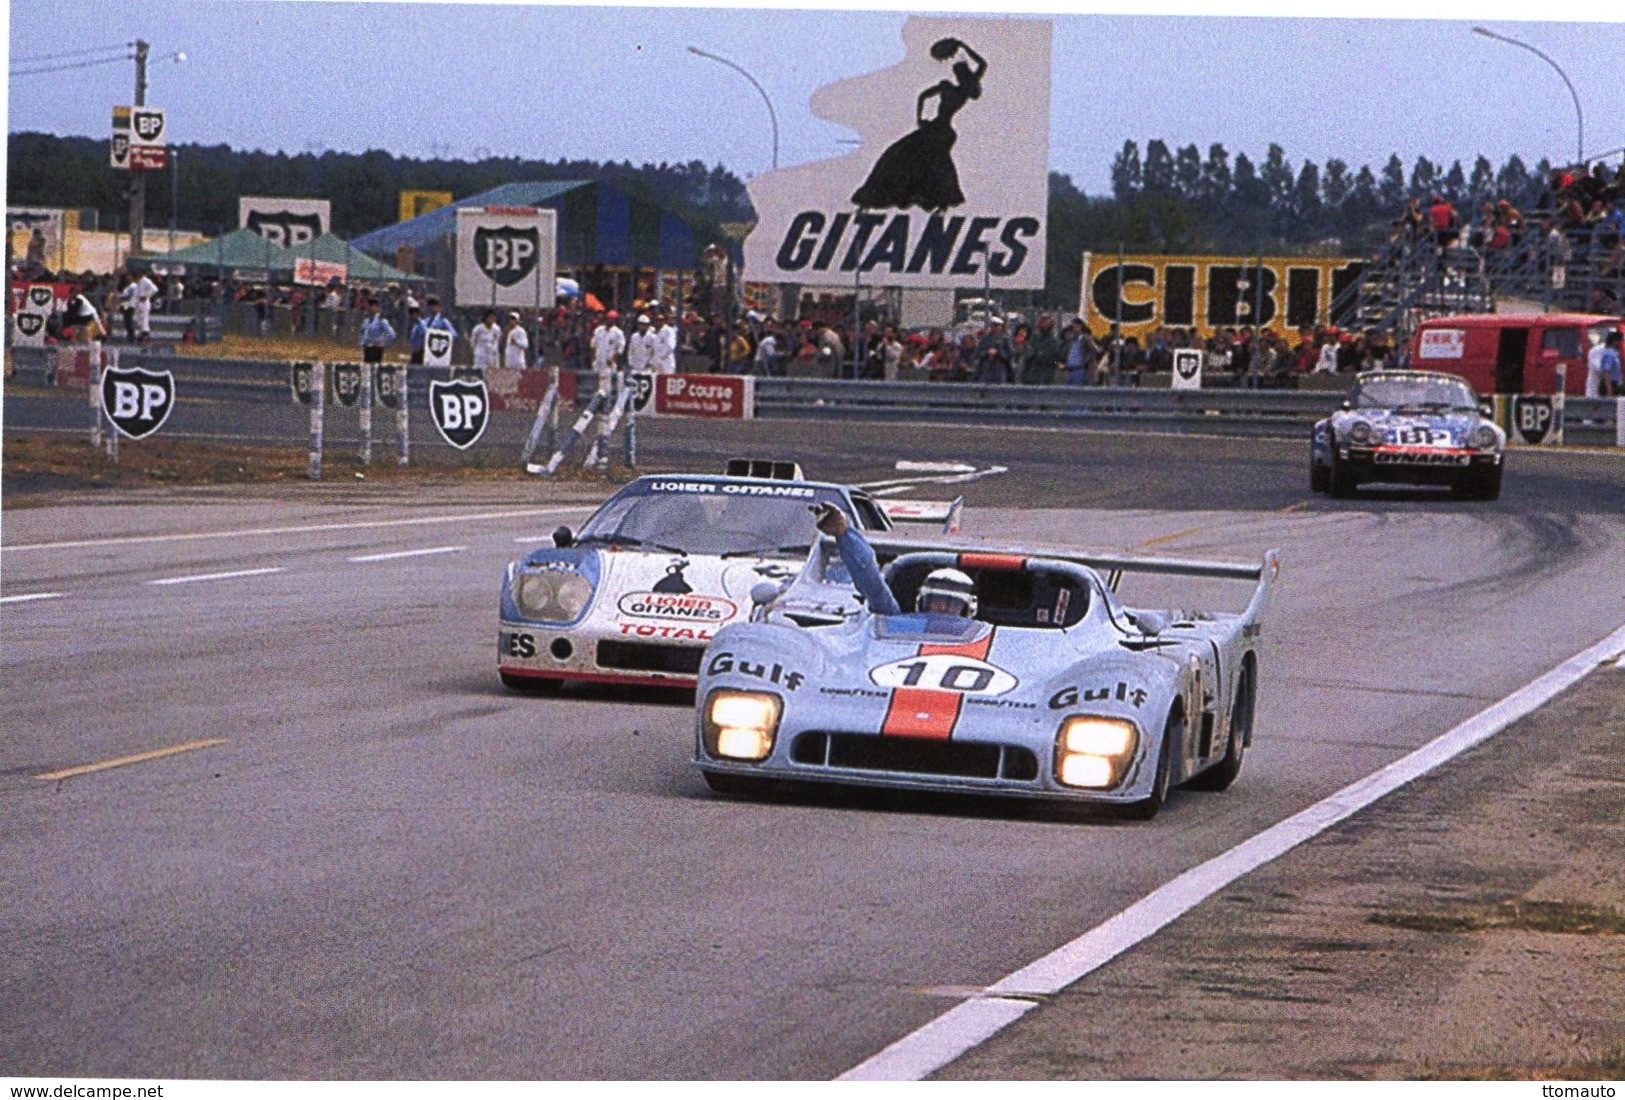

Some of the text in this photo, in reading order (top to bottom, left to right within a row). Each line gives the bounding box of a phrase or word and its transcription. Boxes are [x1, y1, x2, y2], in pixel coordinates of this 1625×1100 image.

[139, 116, 161, 134] BP
[485, 237, 535, 271] BP
[775, 206, 1041, 278] GITANES
[431, 338, 447, 352] BP
[1180, 356, 1197, 374] BP
[339, 371, 361, 395] BP
[666, 377, 733, 399] BP course
[112, 381, 166, 421] BP
[440, 394, 483, 430] BP
[1520, 403, 1550, 431] BP
[1398, 427, 1449, 444] BP
[722, 485, 815, 498] GITANES
[631, 602, 721, 619] GITANES
[620, 622, 713, 641] TOTAL
[510, 632, 535, 658] ES
[707, 651, 805, 692] Gulf
[897, 660, 995, 693] 10
[1049, 681, 1147, 710] Gulf
